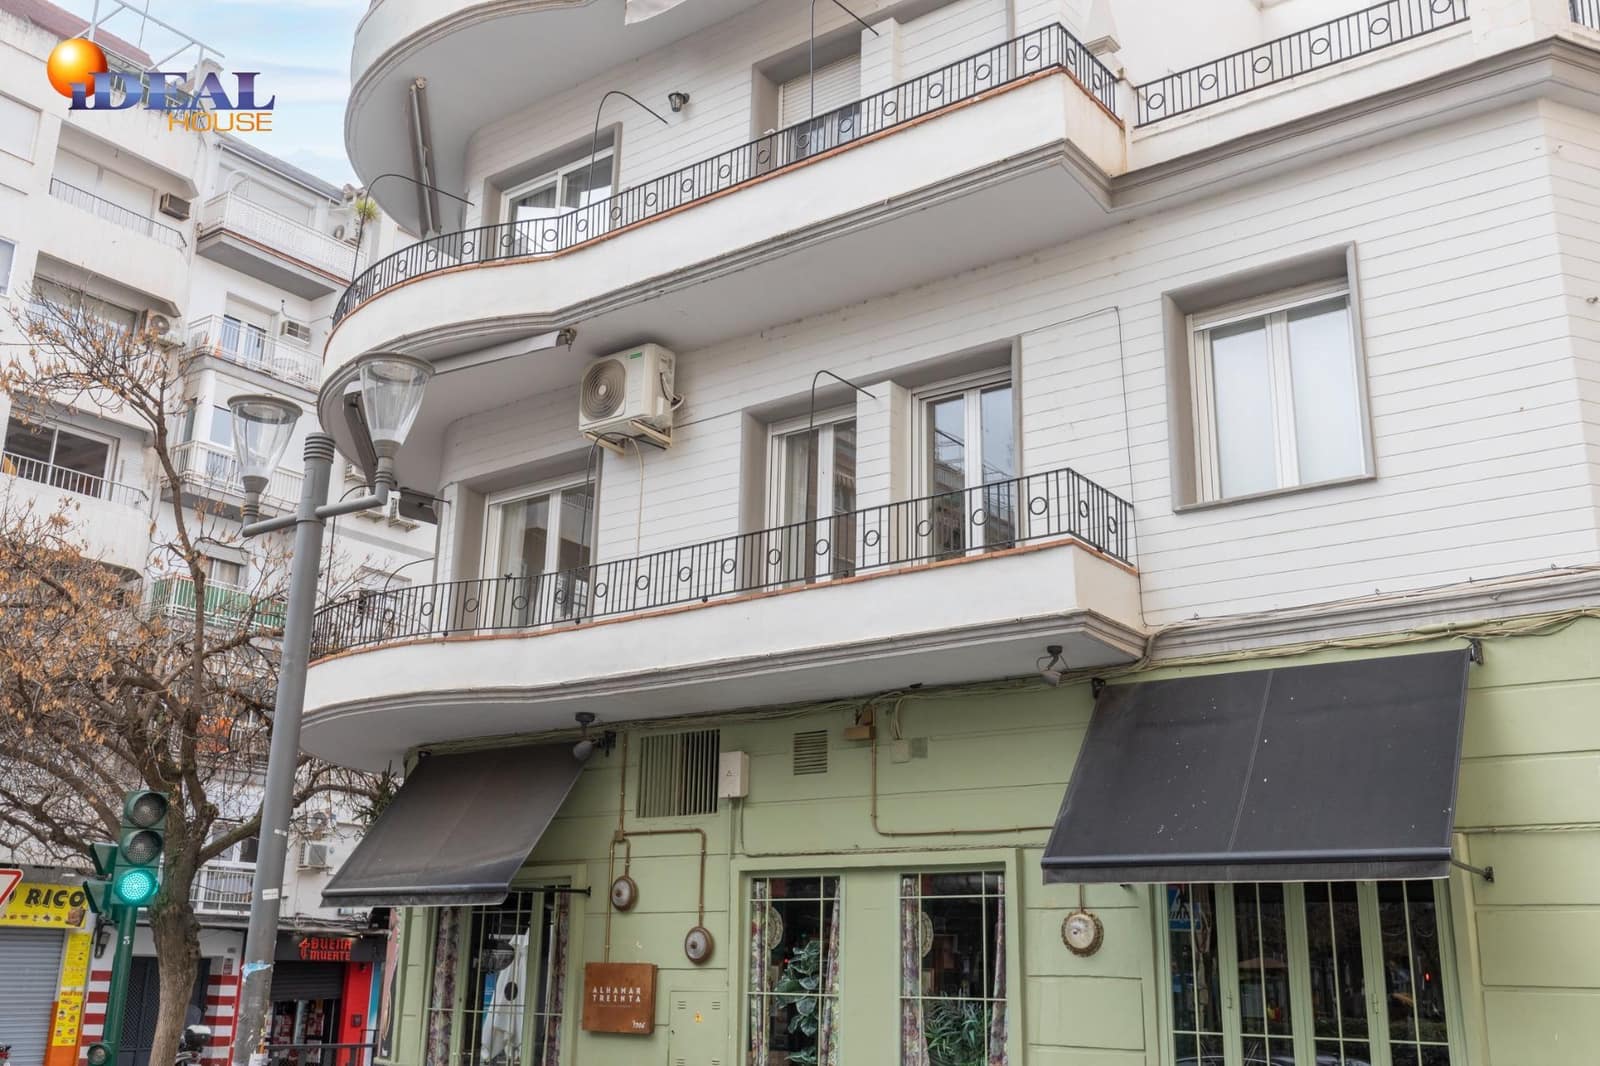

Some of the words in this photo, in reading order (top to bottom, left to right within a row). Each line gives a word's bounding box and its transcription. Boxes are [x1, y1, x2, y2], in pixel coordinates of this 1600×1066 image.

[24, 888, 85, 908] RICO
[310, 950, 351, 960] MUERTE
[592, 986, 641, 994] ALHAMAR
[592, 994, 641, 1002] TREINTA
